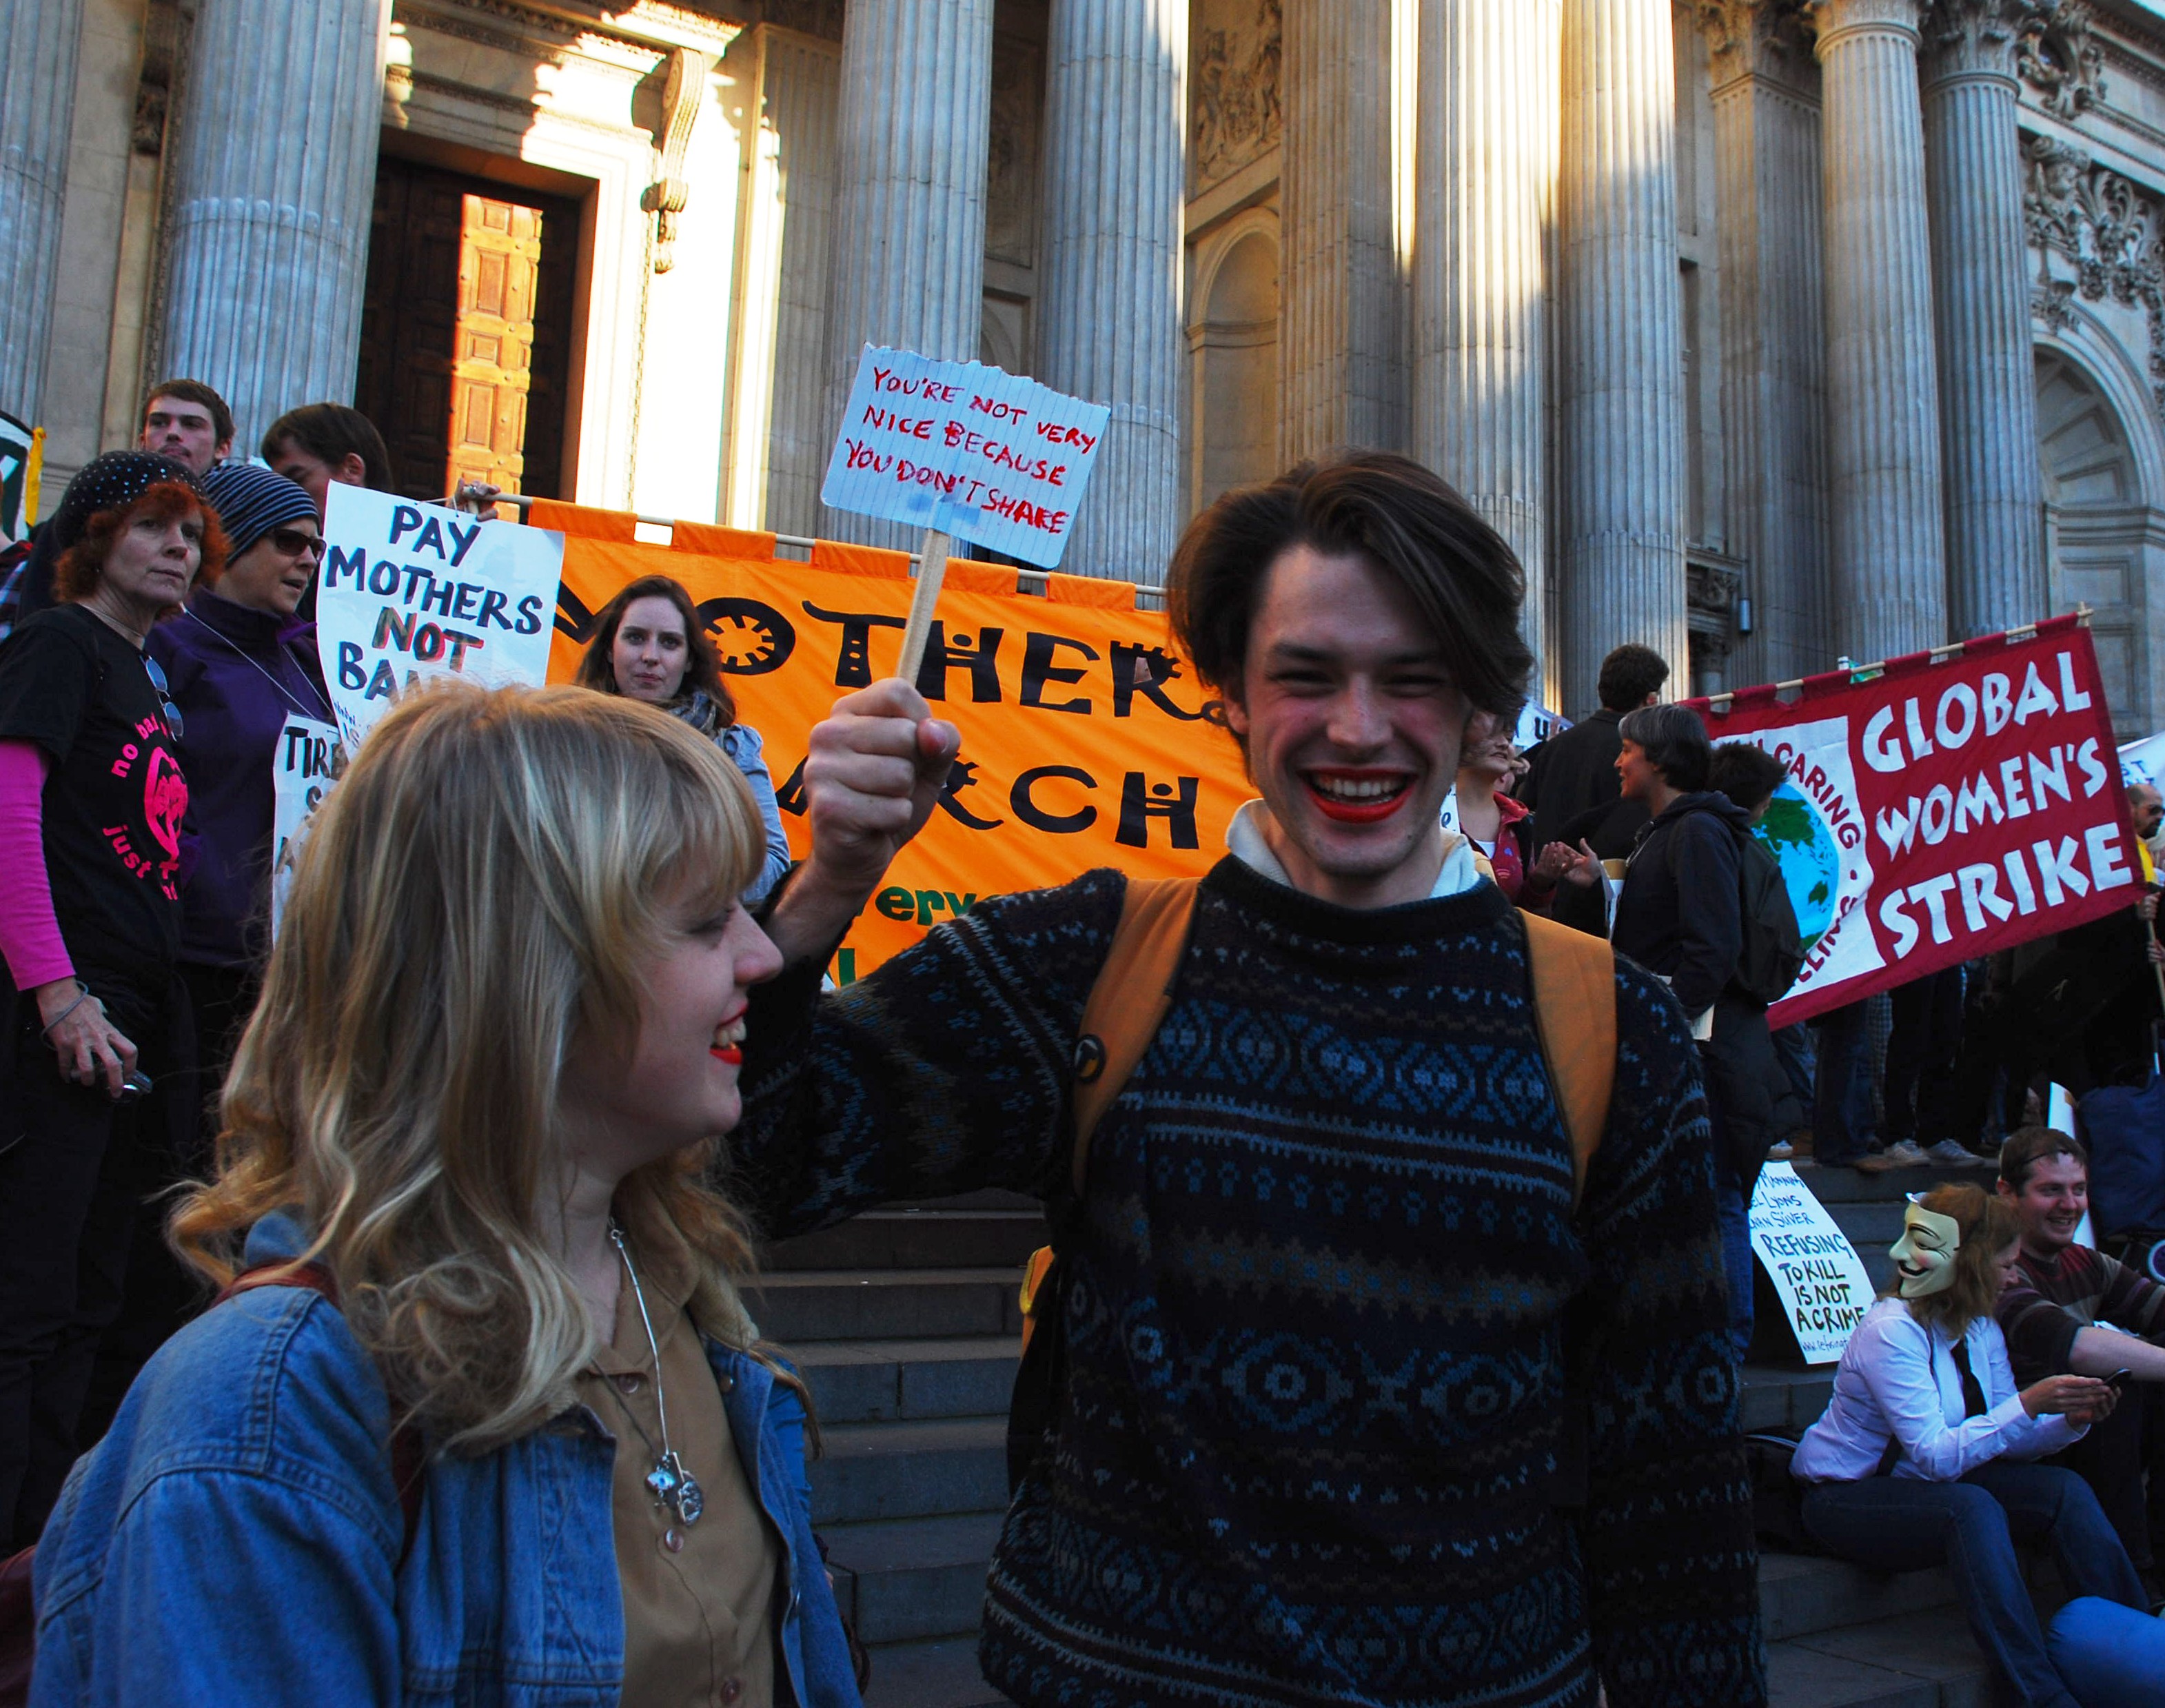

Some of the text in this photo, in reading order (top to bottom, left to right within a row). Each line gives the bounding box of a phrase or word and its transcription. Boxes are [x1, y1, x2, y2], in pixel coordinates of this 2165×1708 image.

[863, 405, 1067, 487] NICE BECAUSE
[874, 366, 1096, 454] YOU'RE NOT VERY
[845, 437, 1070, 534] YOU DON'T SHARE
[389, 505, 481, 567] PAY
[325, 545, 543, 635] MOTHERS
[372, 607, 484, 673] NOT
[553, 580, 1228, 726] OTHER
[1862, 651, 2091, 773] GLOBAL
[111, 743, 138, 778] no
[1773, 742, 1860, 849] CARING
[1876, 737, 2107, 862] WOMEN'S
[103, 825, 152, 879] just
[1879, 822, 2133, 959] STRIKE
[1760, 1233, 1853, 1259] REFUSING
[1778, 1259, 1846, 1286] TO KILL
[1793, 1284, 1850, 1305] IS NOT
[1796, 1307, 1812, 1333] A
